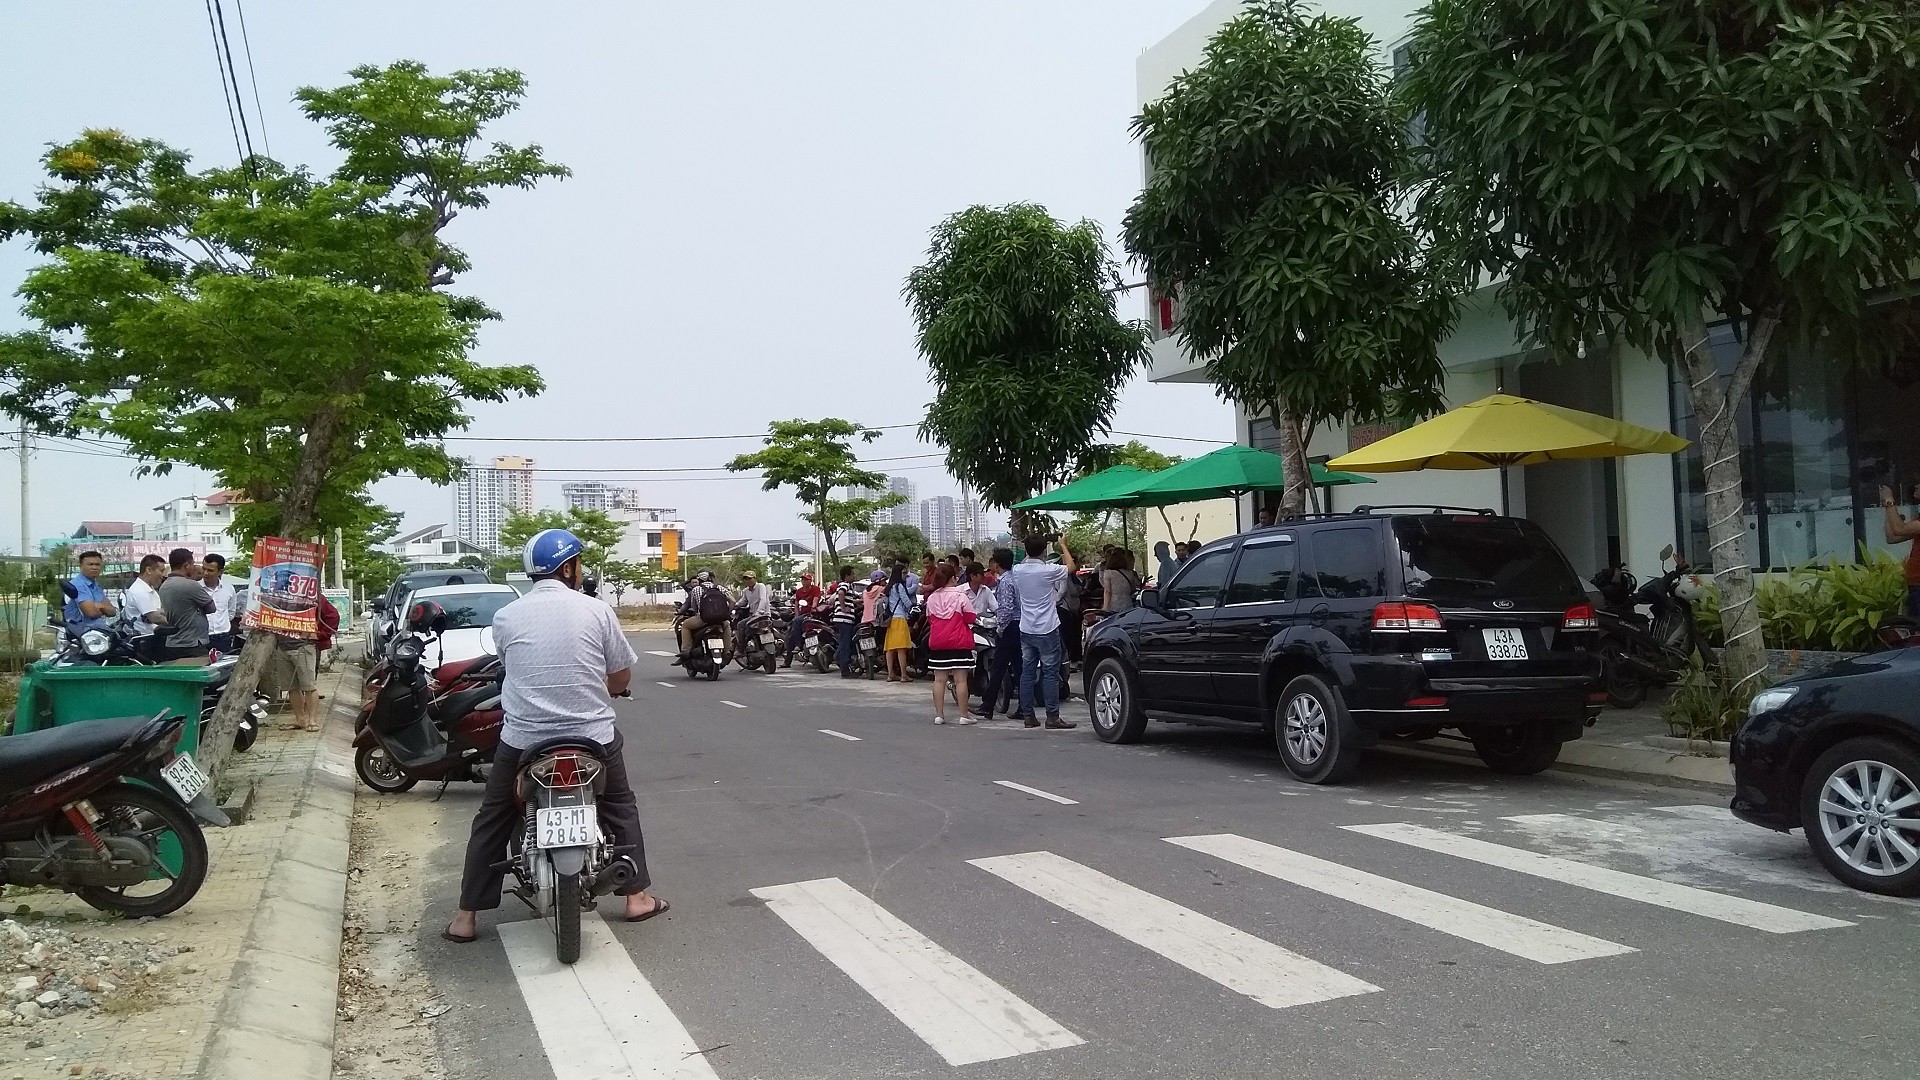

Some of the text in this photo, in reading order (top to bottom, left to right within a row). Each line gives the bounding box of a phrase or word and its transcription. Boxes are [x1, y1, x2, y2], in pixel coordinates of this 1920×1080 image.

[288, 574, 318, 599] 379
[1494, 630, 1516, 644] 43A
[1488, 644, 1527, 659] 338.26
[169, 757, 194, 784] 92-H1
[181, 770, 206, 797] 3302
[546, 808, 586, 827] 43-M1
[545, 826, 588, 846] 2845
